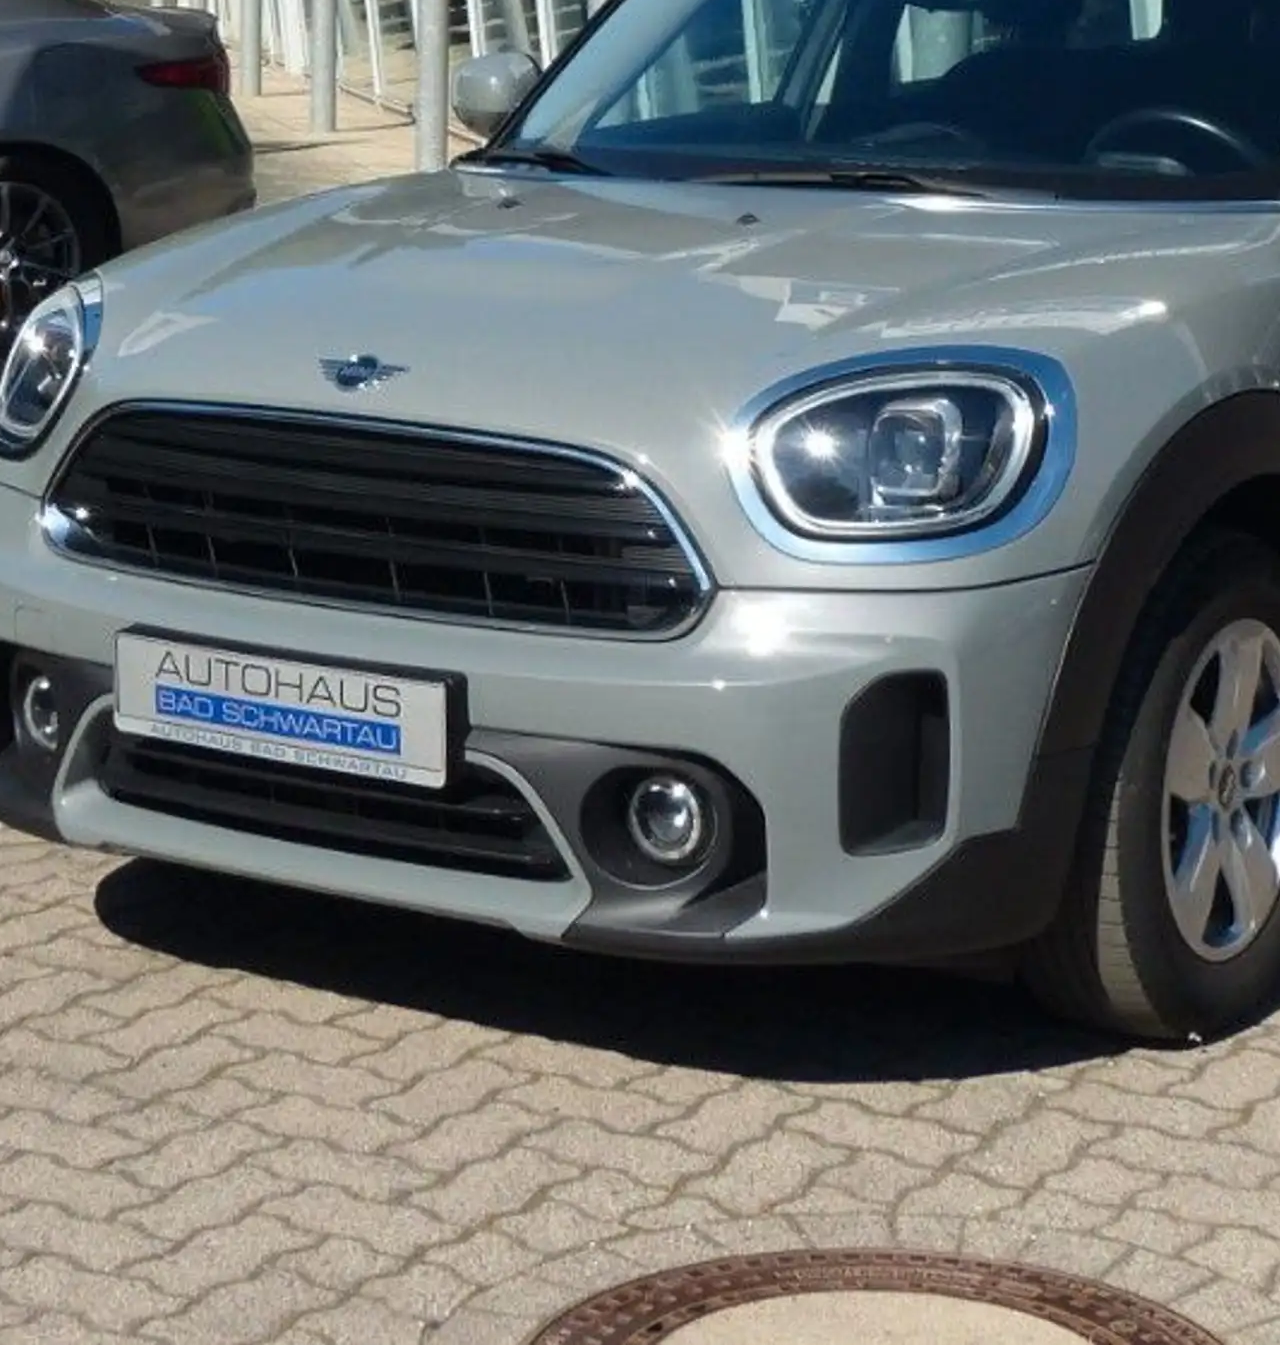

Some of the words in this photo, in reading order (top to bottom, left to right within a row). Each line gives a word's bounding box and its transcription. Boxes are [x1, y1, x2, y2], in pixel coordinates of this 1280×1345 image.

[155, 650, 402, 718] AUTOHAUS
[158, 689, 214, 719] BAD
[221, 700, 398, 751] SCHWARTAU
[150, 722, 244, 753] AUTOHAUS
[250, 740, 287, 760] BAD
[293, 747, 407, 782] SCHWARTAU
